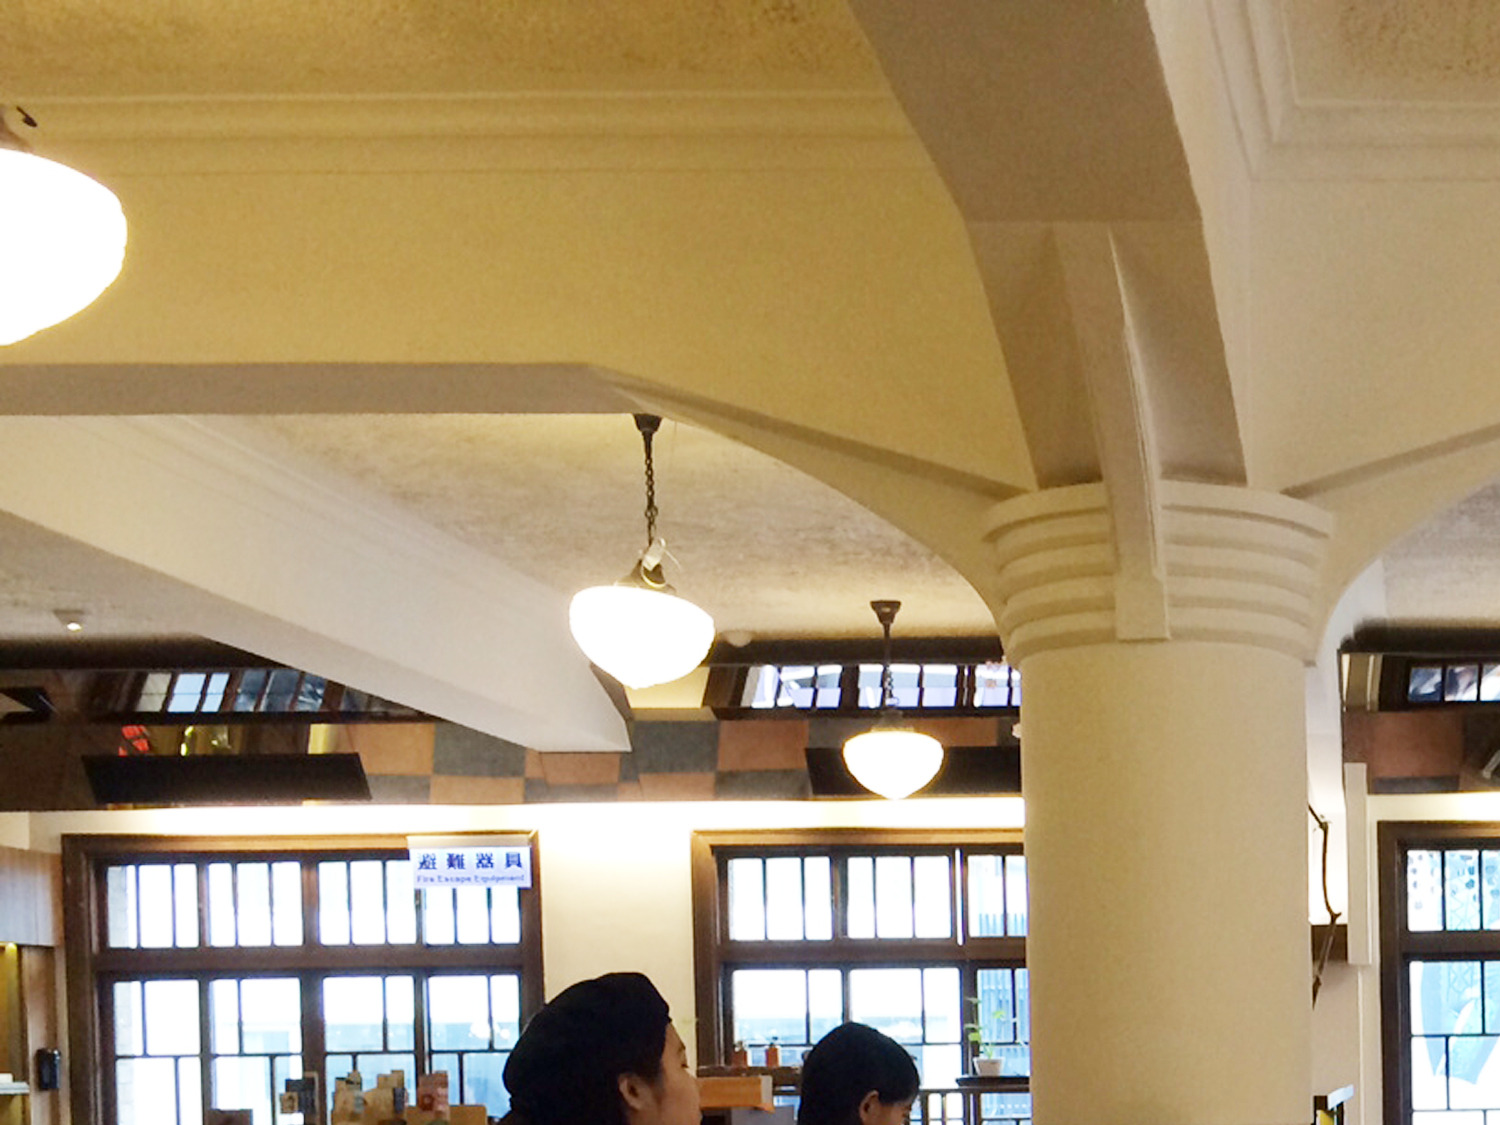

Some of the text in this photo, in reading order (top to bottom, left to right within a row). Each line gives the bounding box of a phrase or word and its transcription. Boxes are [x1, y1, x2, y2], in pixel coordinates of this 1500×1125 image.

[416, 874, 525, 883] Fire Escape Equipment
